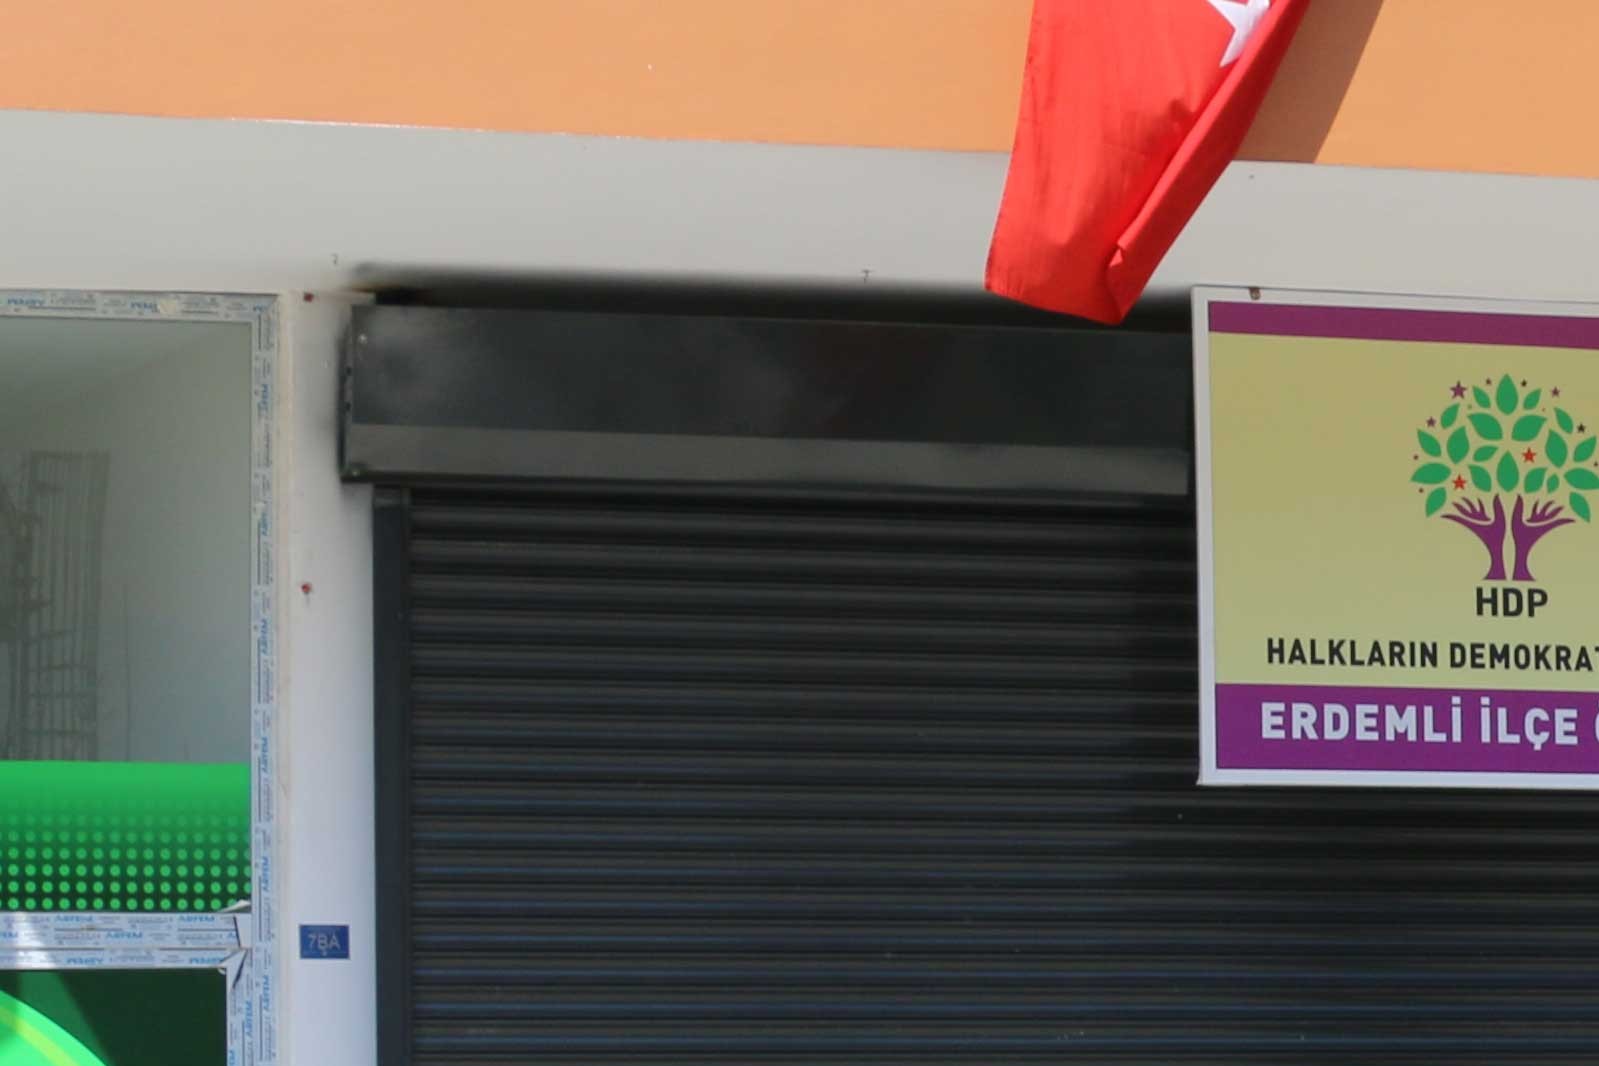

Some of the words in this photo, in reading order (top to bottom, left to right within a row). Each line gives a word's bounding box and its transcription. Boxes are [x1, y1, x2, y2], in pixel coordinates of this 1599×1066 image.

[1475, 587, 1549, 619] HDP
[1266, 636, 1439, 669] HALKLARIN
[1260, 695, 1463, 744] ERDEMLİ
[1480, 696, 1579, 750] İLÇE
